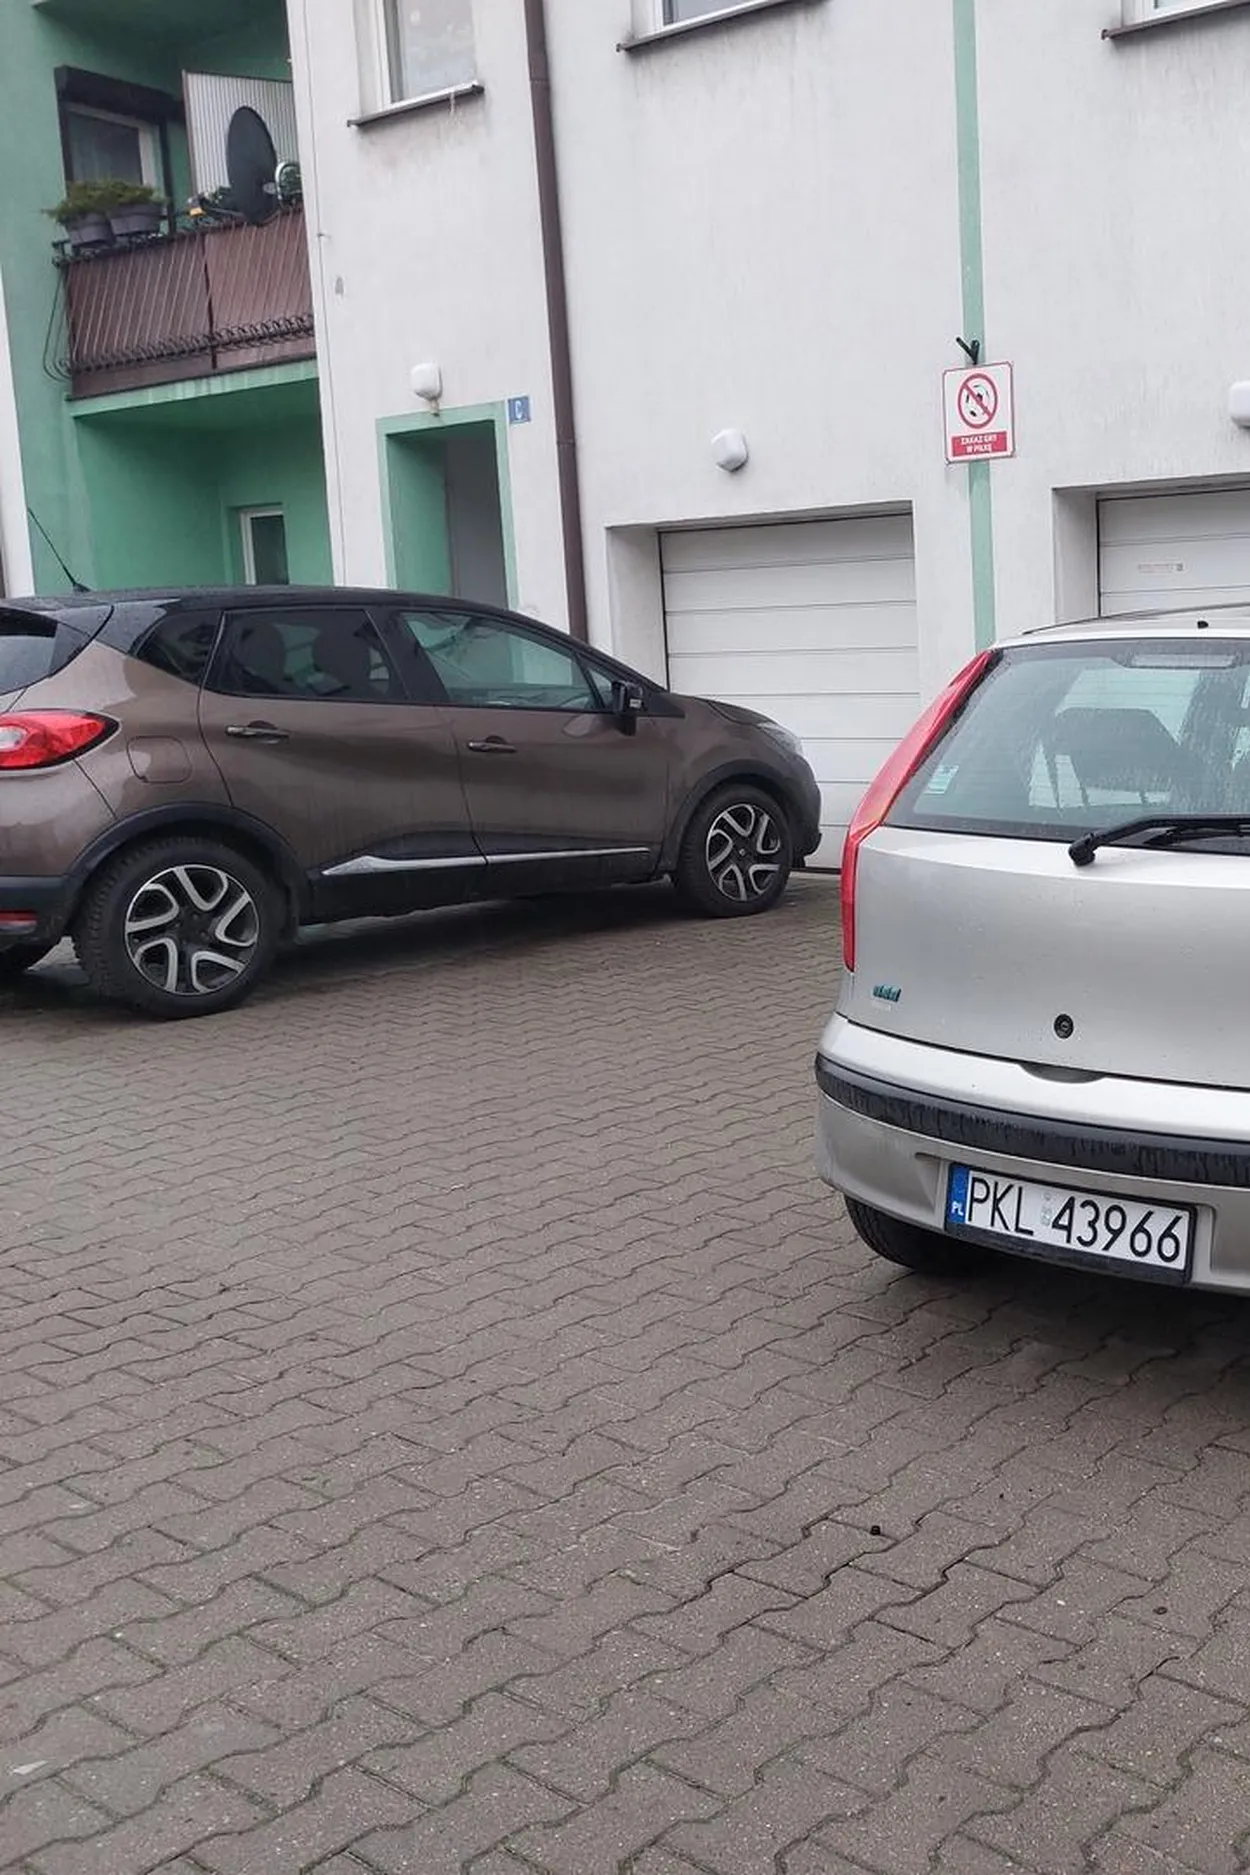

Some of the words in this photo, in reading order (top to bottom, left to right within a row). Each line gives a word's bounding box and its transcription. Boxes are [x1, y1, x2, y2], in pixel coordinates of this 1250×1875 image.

[951, 1200, 964, 1216] PL
[967, 1176, 1034, 1236] PKL
[1051, 1196, 1183, 1263] 43966
